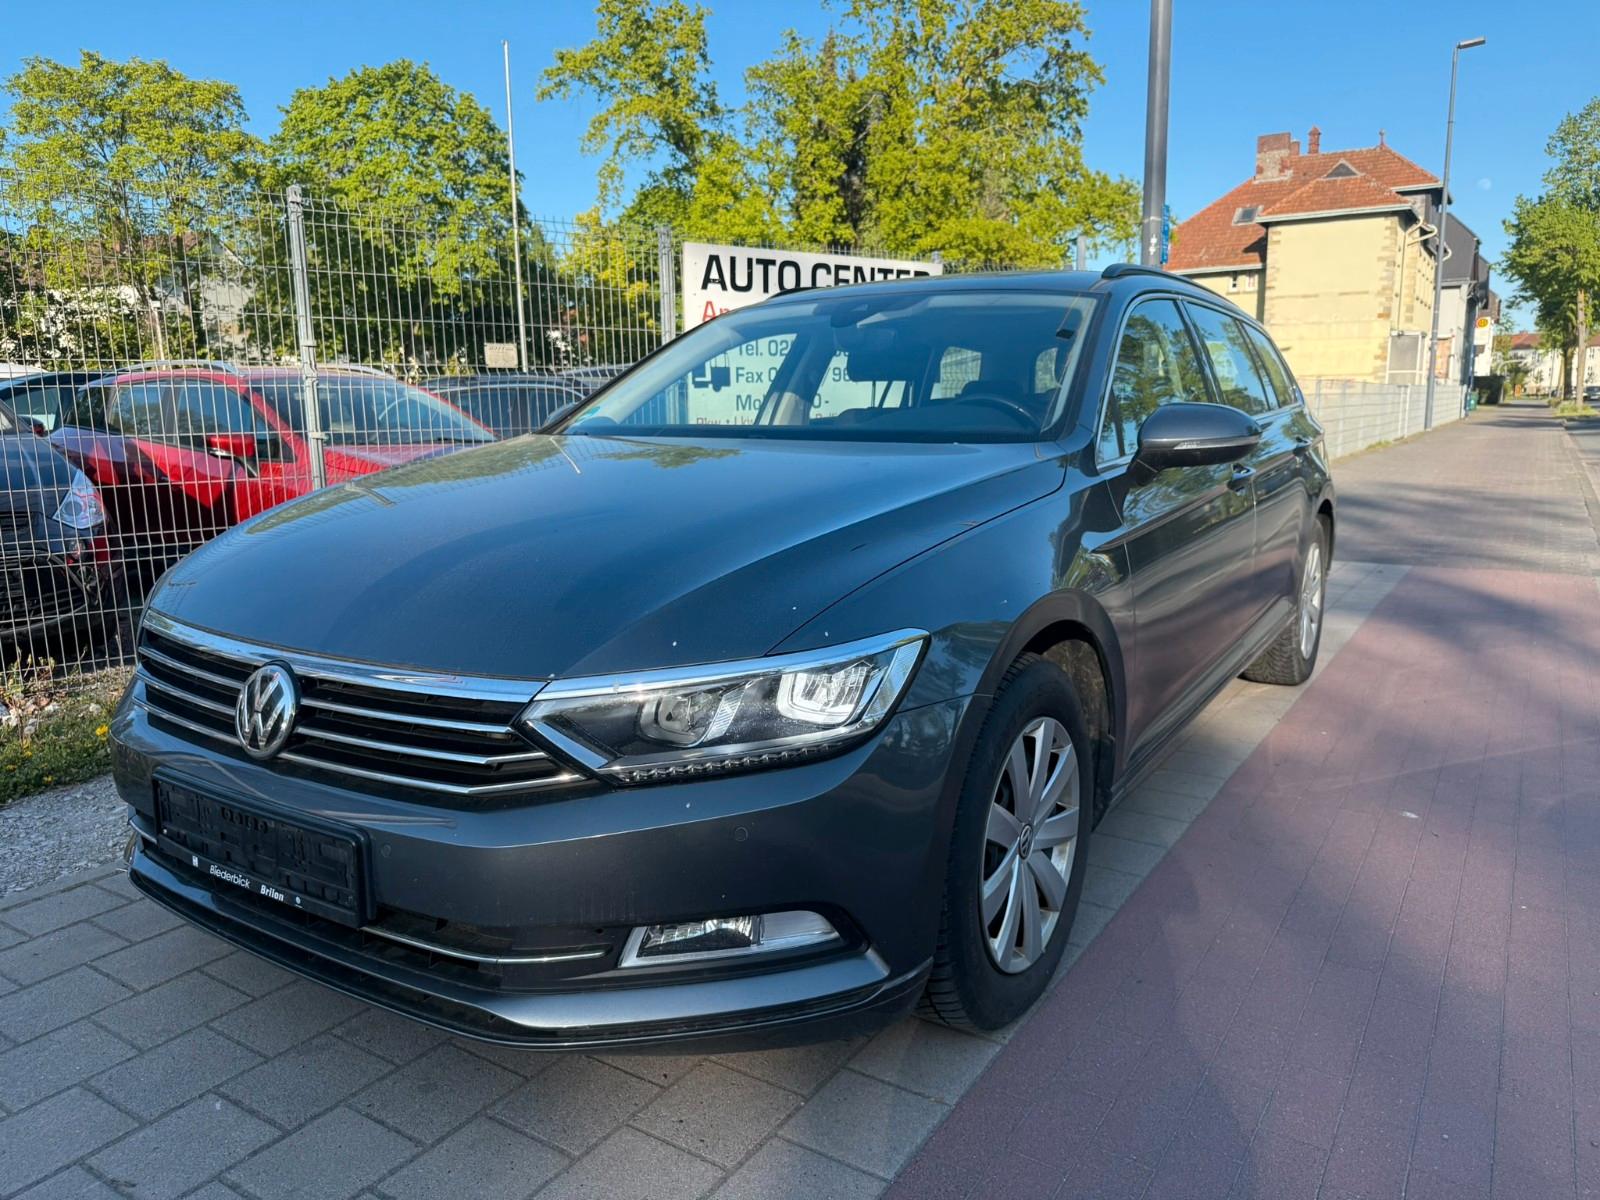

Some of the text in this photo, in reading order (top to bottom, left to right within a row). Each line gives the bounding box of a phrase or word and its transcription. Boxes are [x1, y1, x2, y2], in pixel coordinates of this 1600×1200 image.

[701, 254, 801, 293] AUTO
[735, 366, 763, 383] Fax
[736, 394, 766, 411] Mo
[210, 864, 285, 902] Biederbick Brilon
